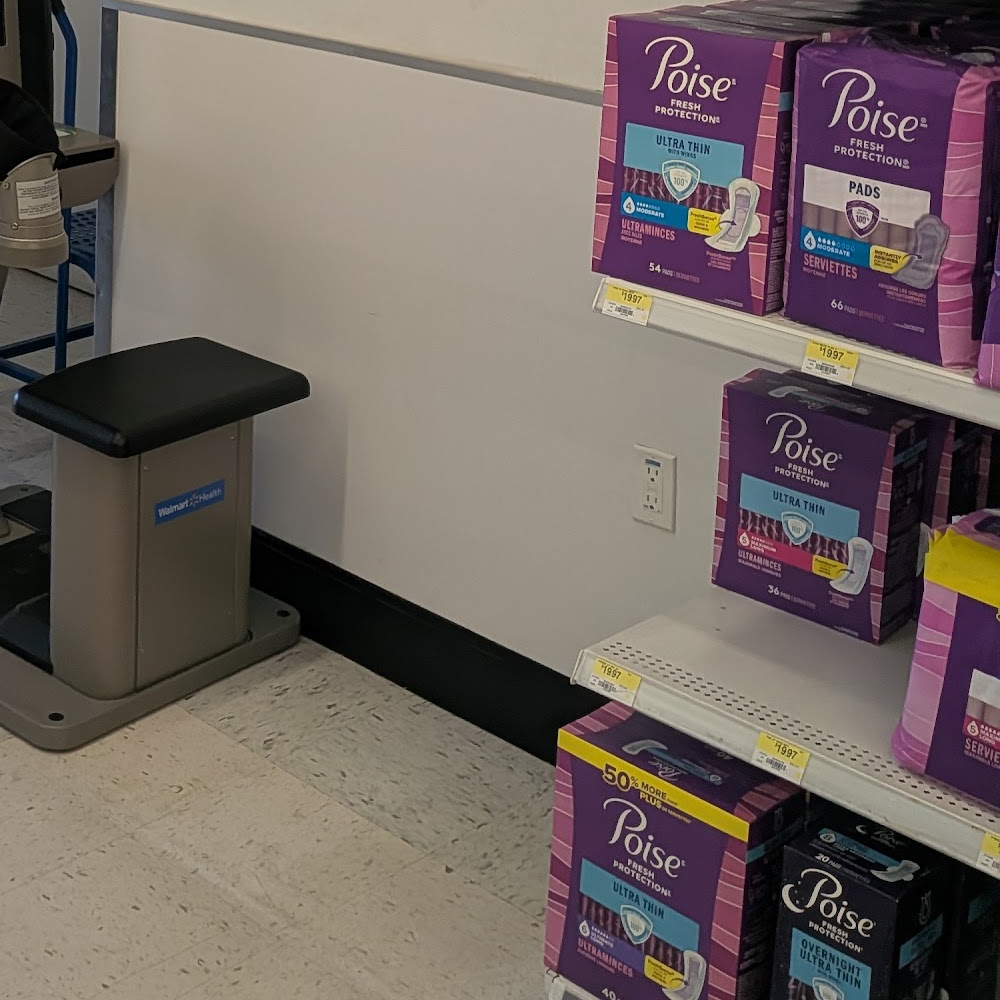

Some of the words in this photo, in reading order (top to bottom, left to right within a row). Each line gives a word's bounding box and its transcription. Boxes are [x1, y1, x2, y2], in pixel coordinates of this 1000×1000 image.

[645, 36, 734, 102] Poise
[655, 106, 717, 125] PROTECTION
[671, 99, 702, 112] FRESH
[822, 68, 920, 143] Poise
[657, 135, 685, 150] ULTRA
[688, 141, 711, 155] THIN
[850, 137, 884, 153] FRESH
[834, 145, 902, 168] PROTECTION
[849, 180, 881, 199] PADS
[626, 202, 632, 212] 4
[636, 207, 665, 218] MODERATE
[622, 219, 676, 241] ULTRAMINCES
[806, 238, 812, 247] 4
[817, 244, 851, 258] MODERATE
[649, 262, 661, 274] 54
[803, 254, 858, 279] SERVIETTES
[831, 299, 844, 311] 66
[766, 412, 840, 472] Poise
[774, 466, 827, 489] PROTECTION
[788, 462, 814, 476] FRESH
[158, 499, 188, 518] Walmart
[199, 488, 222, 503] Health
[773, 490, 800, 508] ULTRA
[804, 500, 826, 516] THIN
[738, 549, 782, 572] ULTRAMINCES
[768, 585, 780, 596] 36
[970, 725, 976, 734] 5
[640, 792, 662, 809] PLUS
[641, 782, 667, 800] MORE
[602, 797, 682, 878] Poise
[815, 853, 828, 862] 20
[613, 860, 668, 897] PROTECTION
[627, 859, 655, 879] FRESH
[613, 881, 640, 906] ULTRA
[643, 899, 665, 920] THIN
[800, 868, 874, 938] Poise
[808, 921, 861, 953] PROTECTION
[822, 920, 849, 939] FRESH
[578, 938, 634, 978] ULTRAMINCES
[802, 939, 862, 977] OVERNIGHT
[800, 948, 832, 972] ULTRA
[837, 967, 861, 989] THIN
[602, 988, 616, 1000] 40
